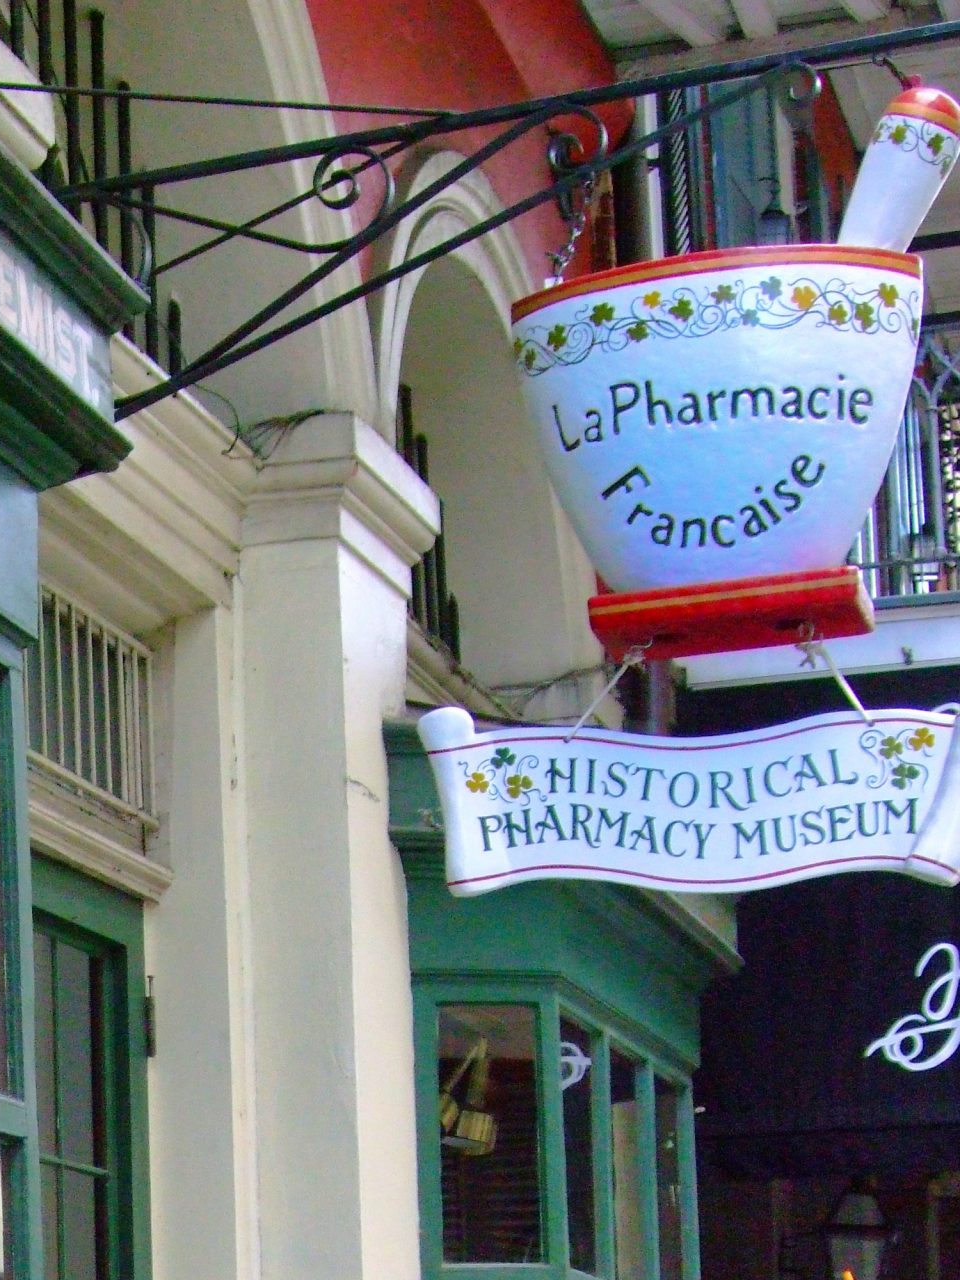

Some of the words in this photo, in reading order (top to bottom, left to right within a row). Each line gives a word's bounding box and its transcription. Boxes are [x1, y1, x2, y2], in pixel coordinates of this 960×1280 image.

[546, 748, 859, 812] HISTORICAL
[478, 803, 717, 860] PHARMACY
[733, 797, 920, 860] MUSEUM
